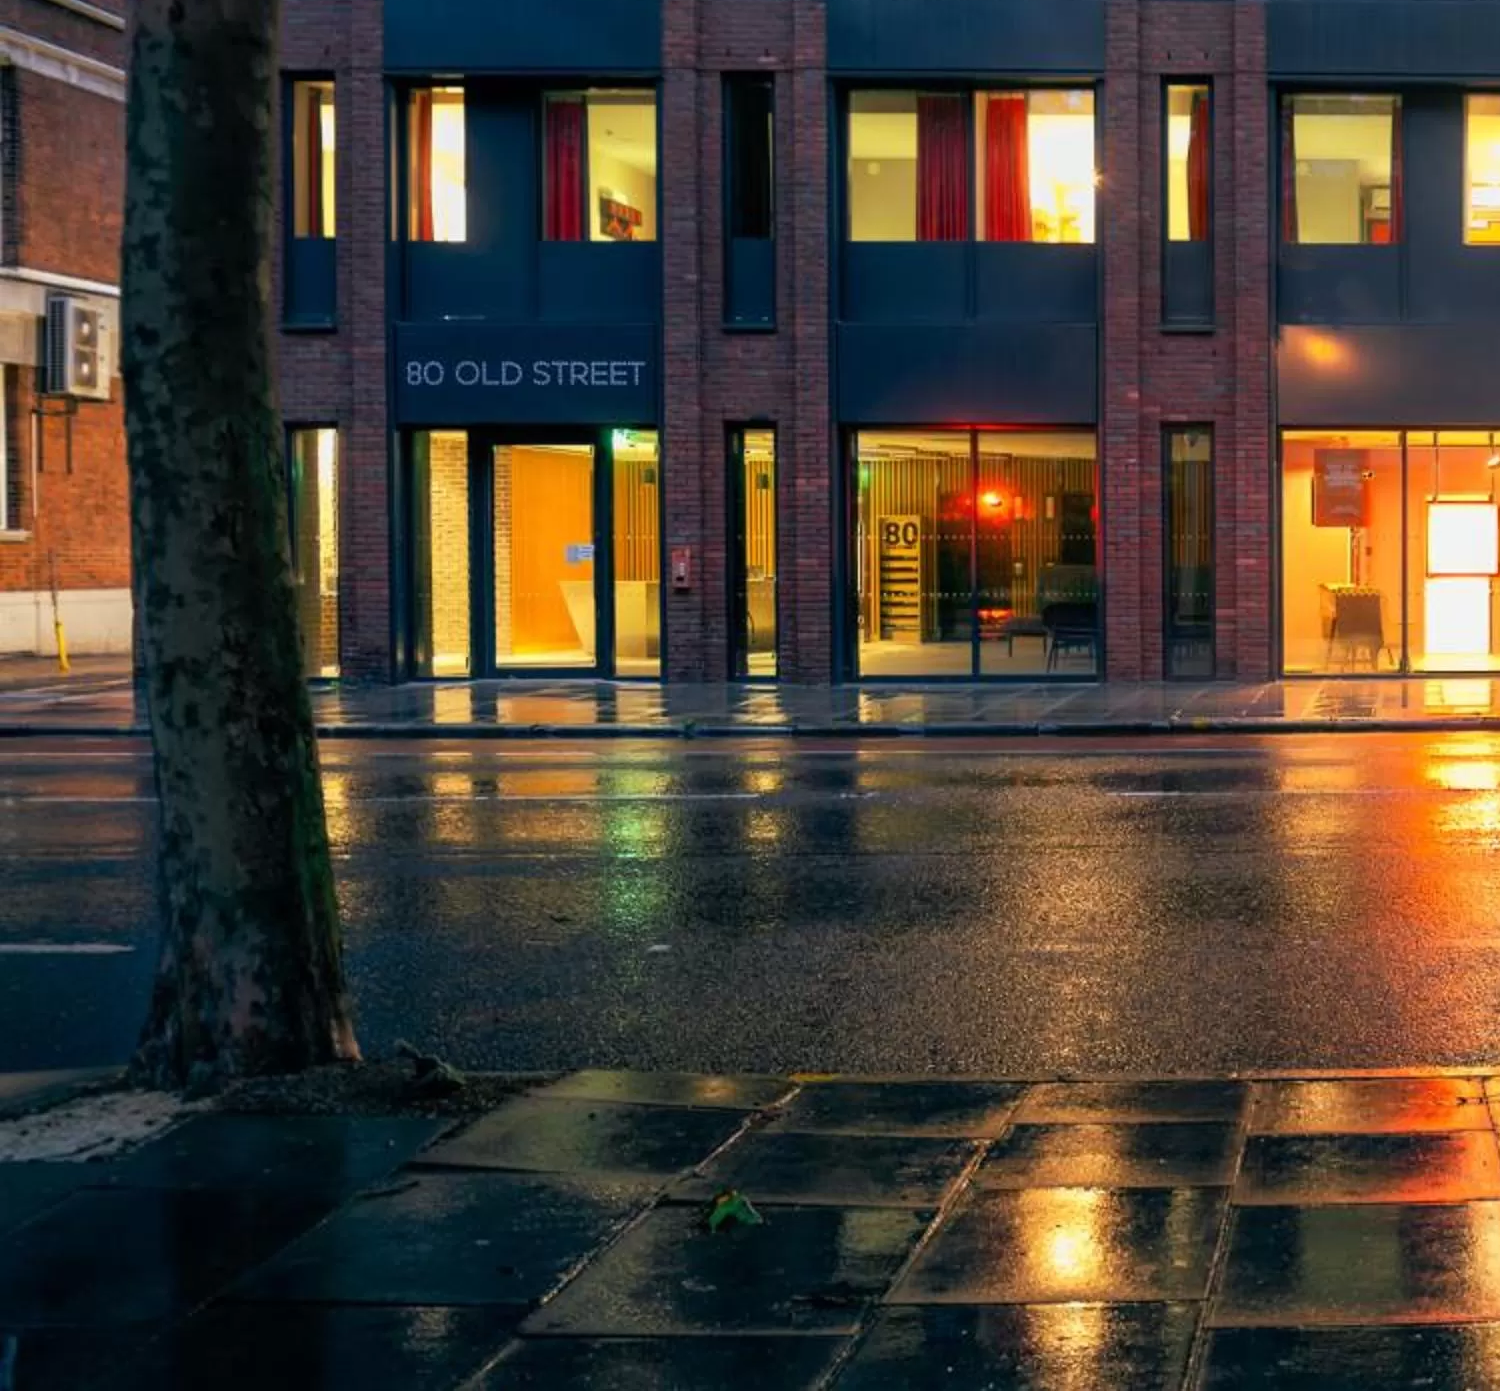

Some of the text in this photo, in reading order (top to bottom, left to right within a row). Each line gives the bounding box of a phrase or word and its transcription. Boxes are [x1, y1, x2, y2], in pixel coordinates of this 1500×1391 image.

[406, 360, 647, 386] 80 OLD STREET
[885, 521, 919, 545] 80
